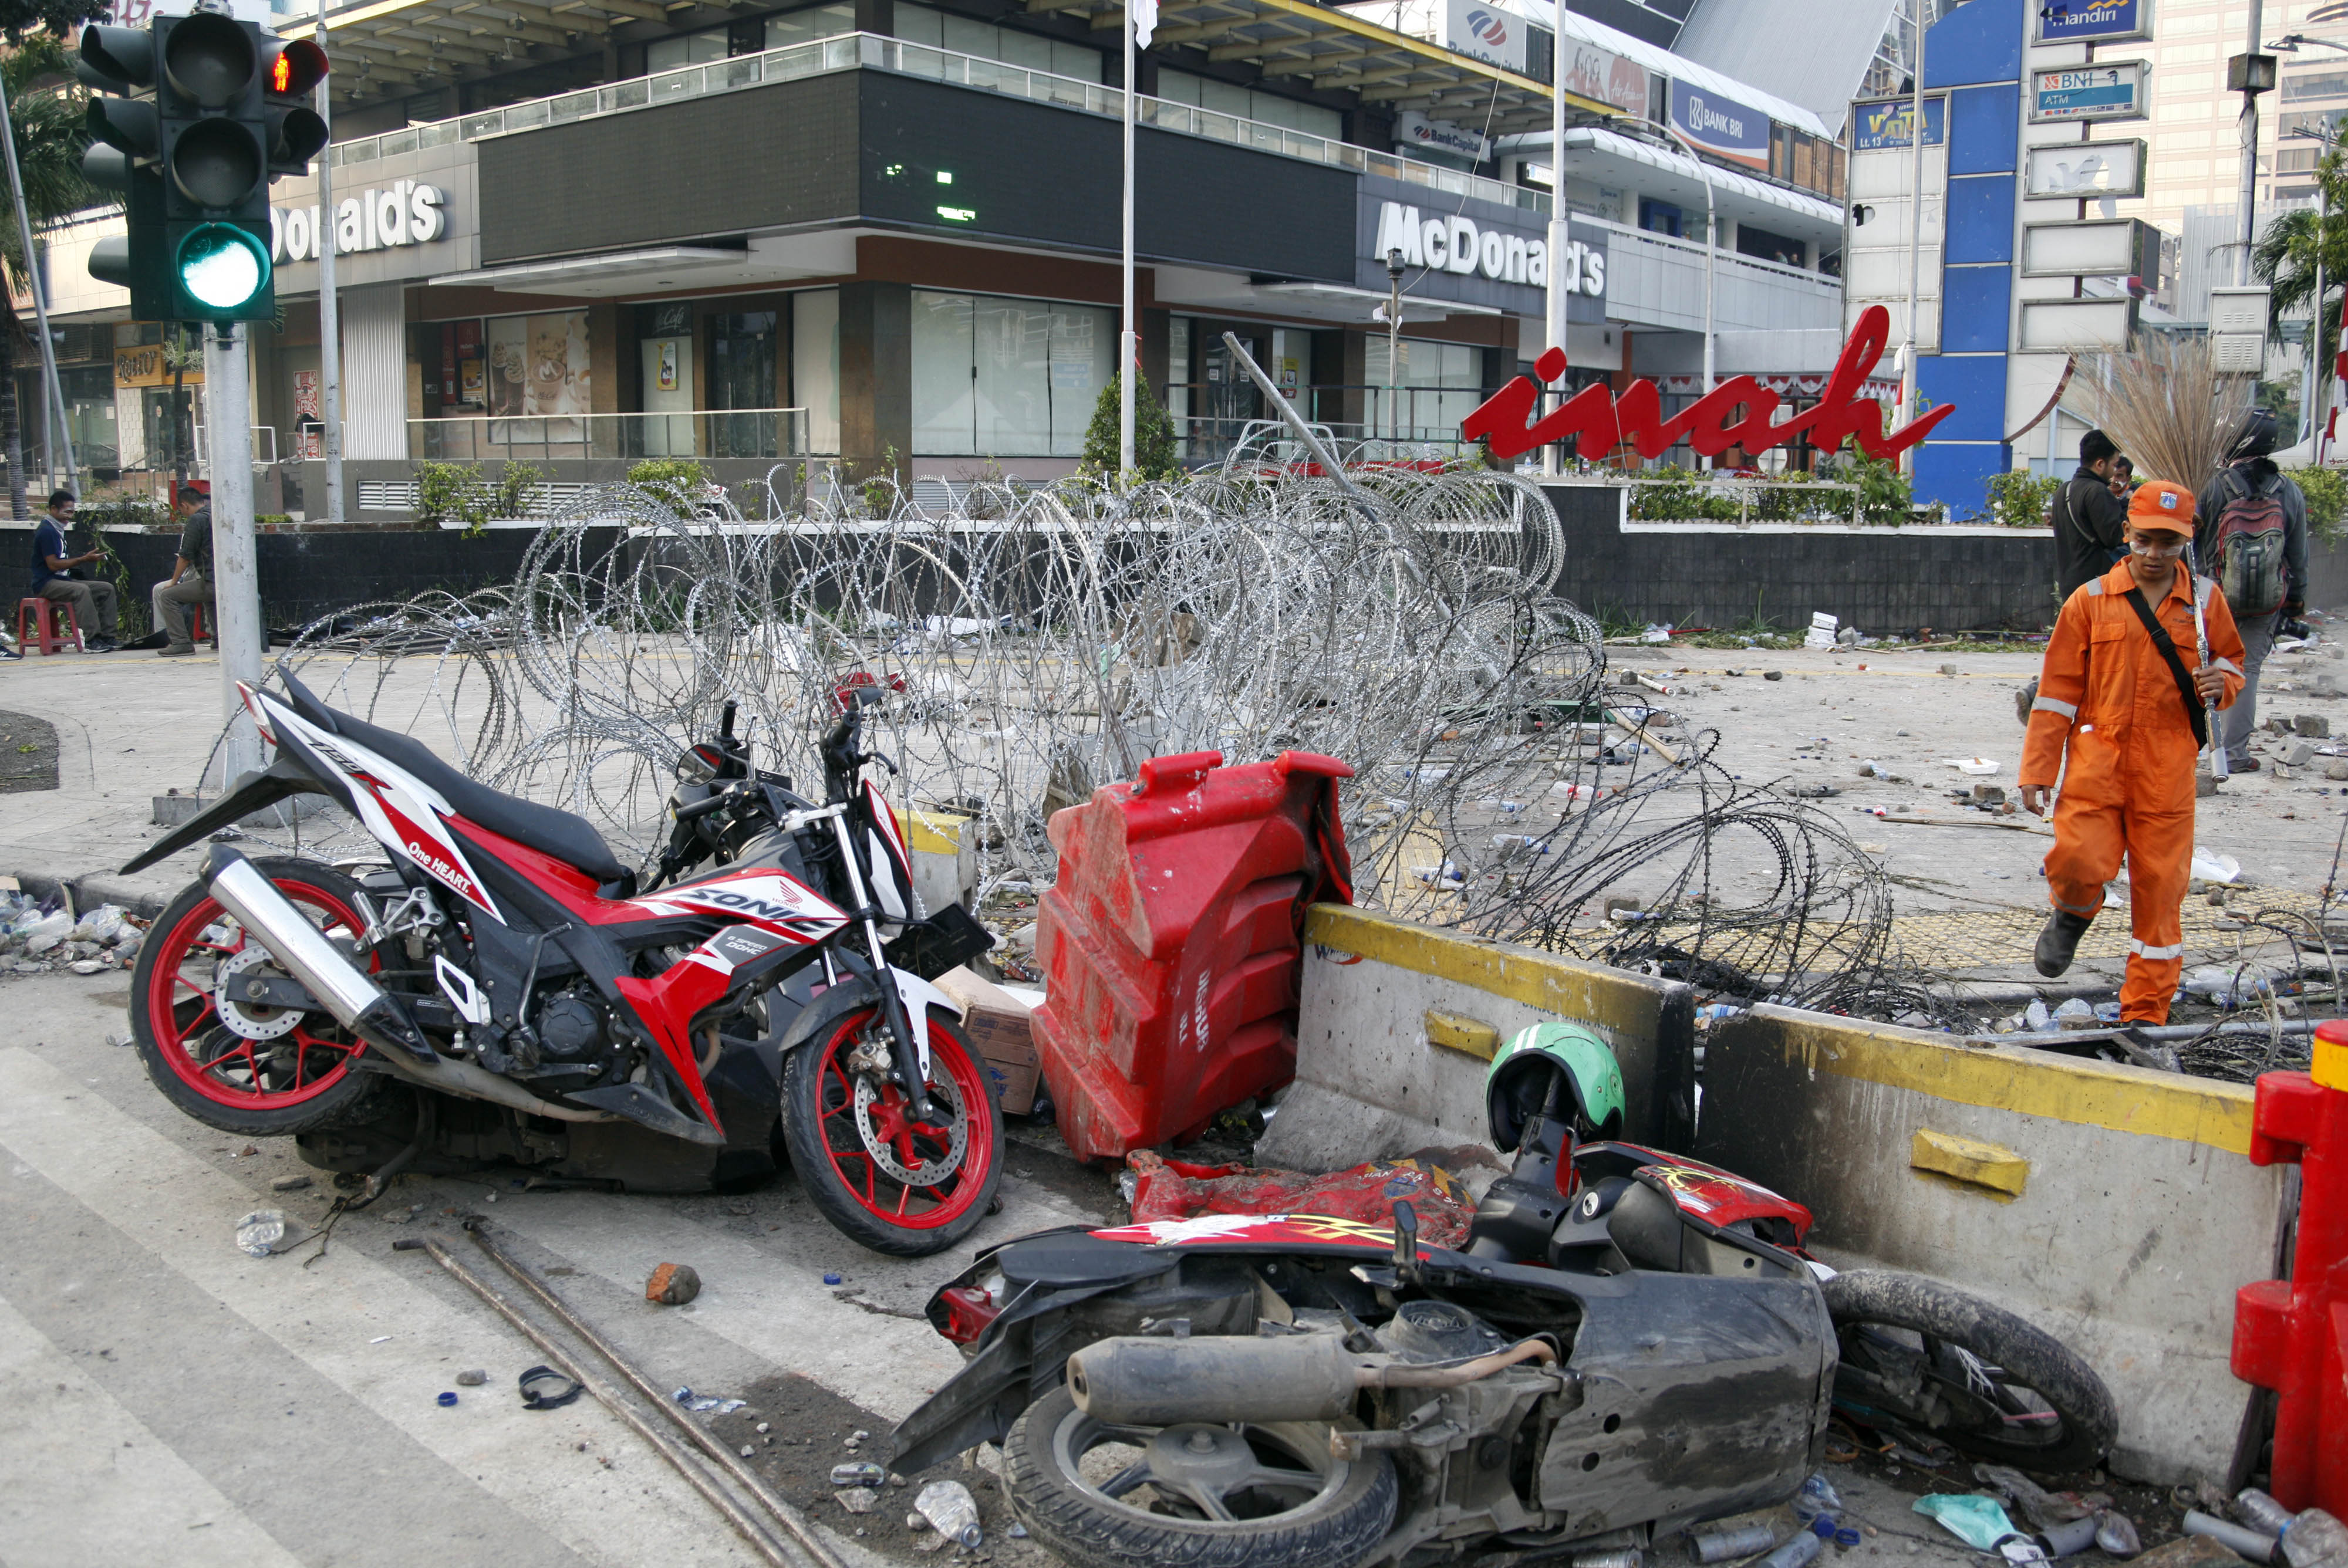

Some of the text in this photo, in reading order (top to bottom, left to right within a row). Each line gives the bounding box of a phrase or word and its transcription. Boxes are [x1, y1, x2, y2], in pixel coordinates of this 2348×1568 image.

[2061, 72, 2093, 88] BNI
[2045, 95, 2069, 105] ATM
[1704, 108, 1743, 139] BANK BRI
[1431, 129, 1481, 153] BankCapital
[1872, 137, 1881, 147] 13
[1375, 201, 1604, 296] McDonald's
[409, 842, 471, 893] One HEART.
[674, 888, 838, 933] SONIC
[772, 897, 800, 910] HONDA
[726, 942, 763, 955] DOHC
[734, 937, 768, 950] SPEED
